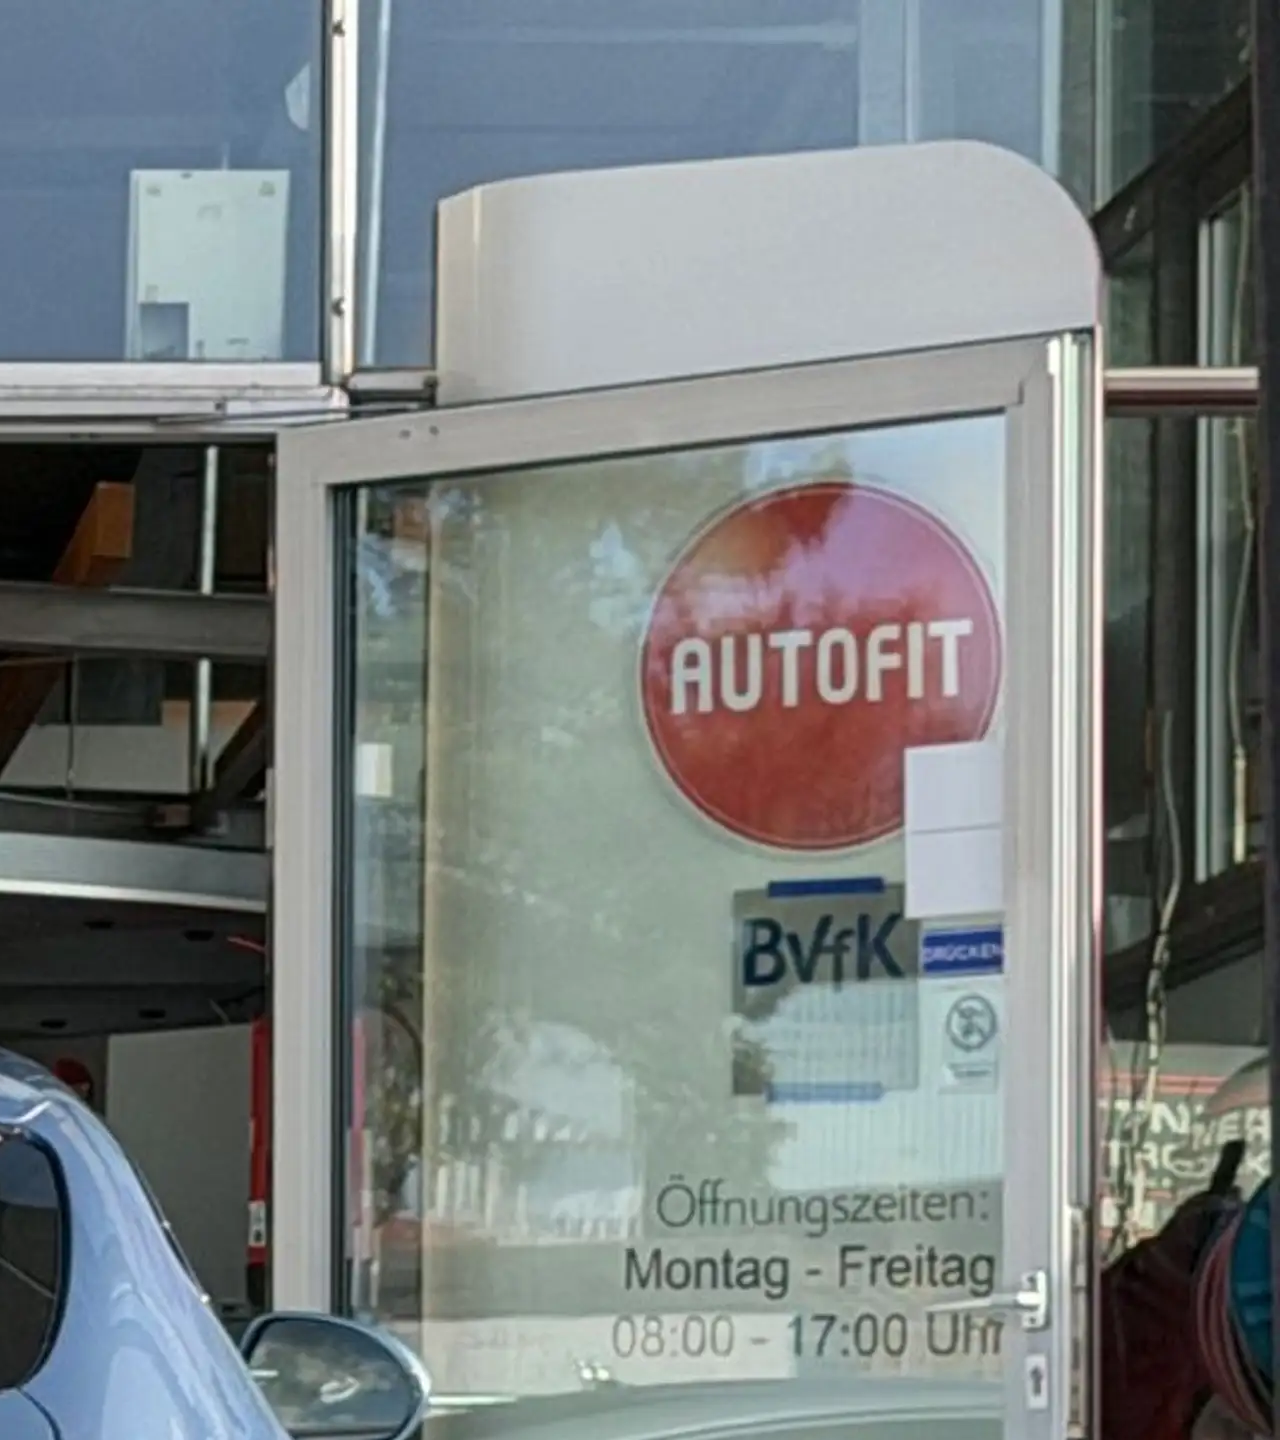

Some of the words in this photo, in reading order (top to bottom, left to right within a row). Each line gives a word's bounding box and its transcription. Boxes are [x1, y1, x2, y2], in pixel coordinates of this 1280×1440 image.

[670, 617, 973, 716] AUTOFIT
[655, 1174, 990, 1238] Öffnungszeiten:
[624, 1247, 790, 1300] Montag
[838, 1244, 996, 1298] Freitag
[611, 1314, 736, 1358] 08:00
[788, 1313, 908, 1358] 17:00
[926, 1310, 1005, 1356] Uhr
